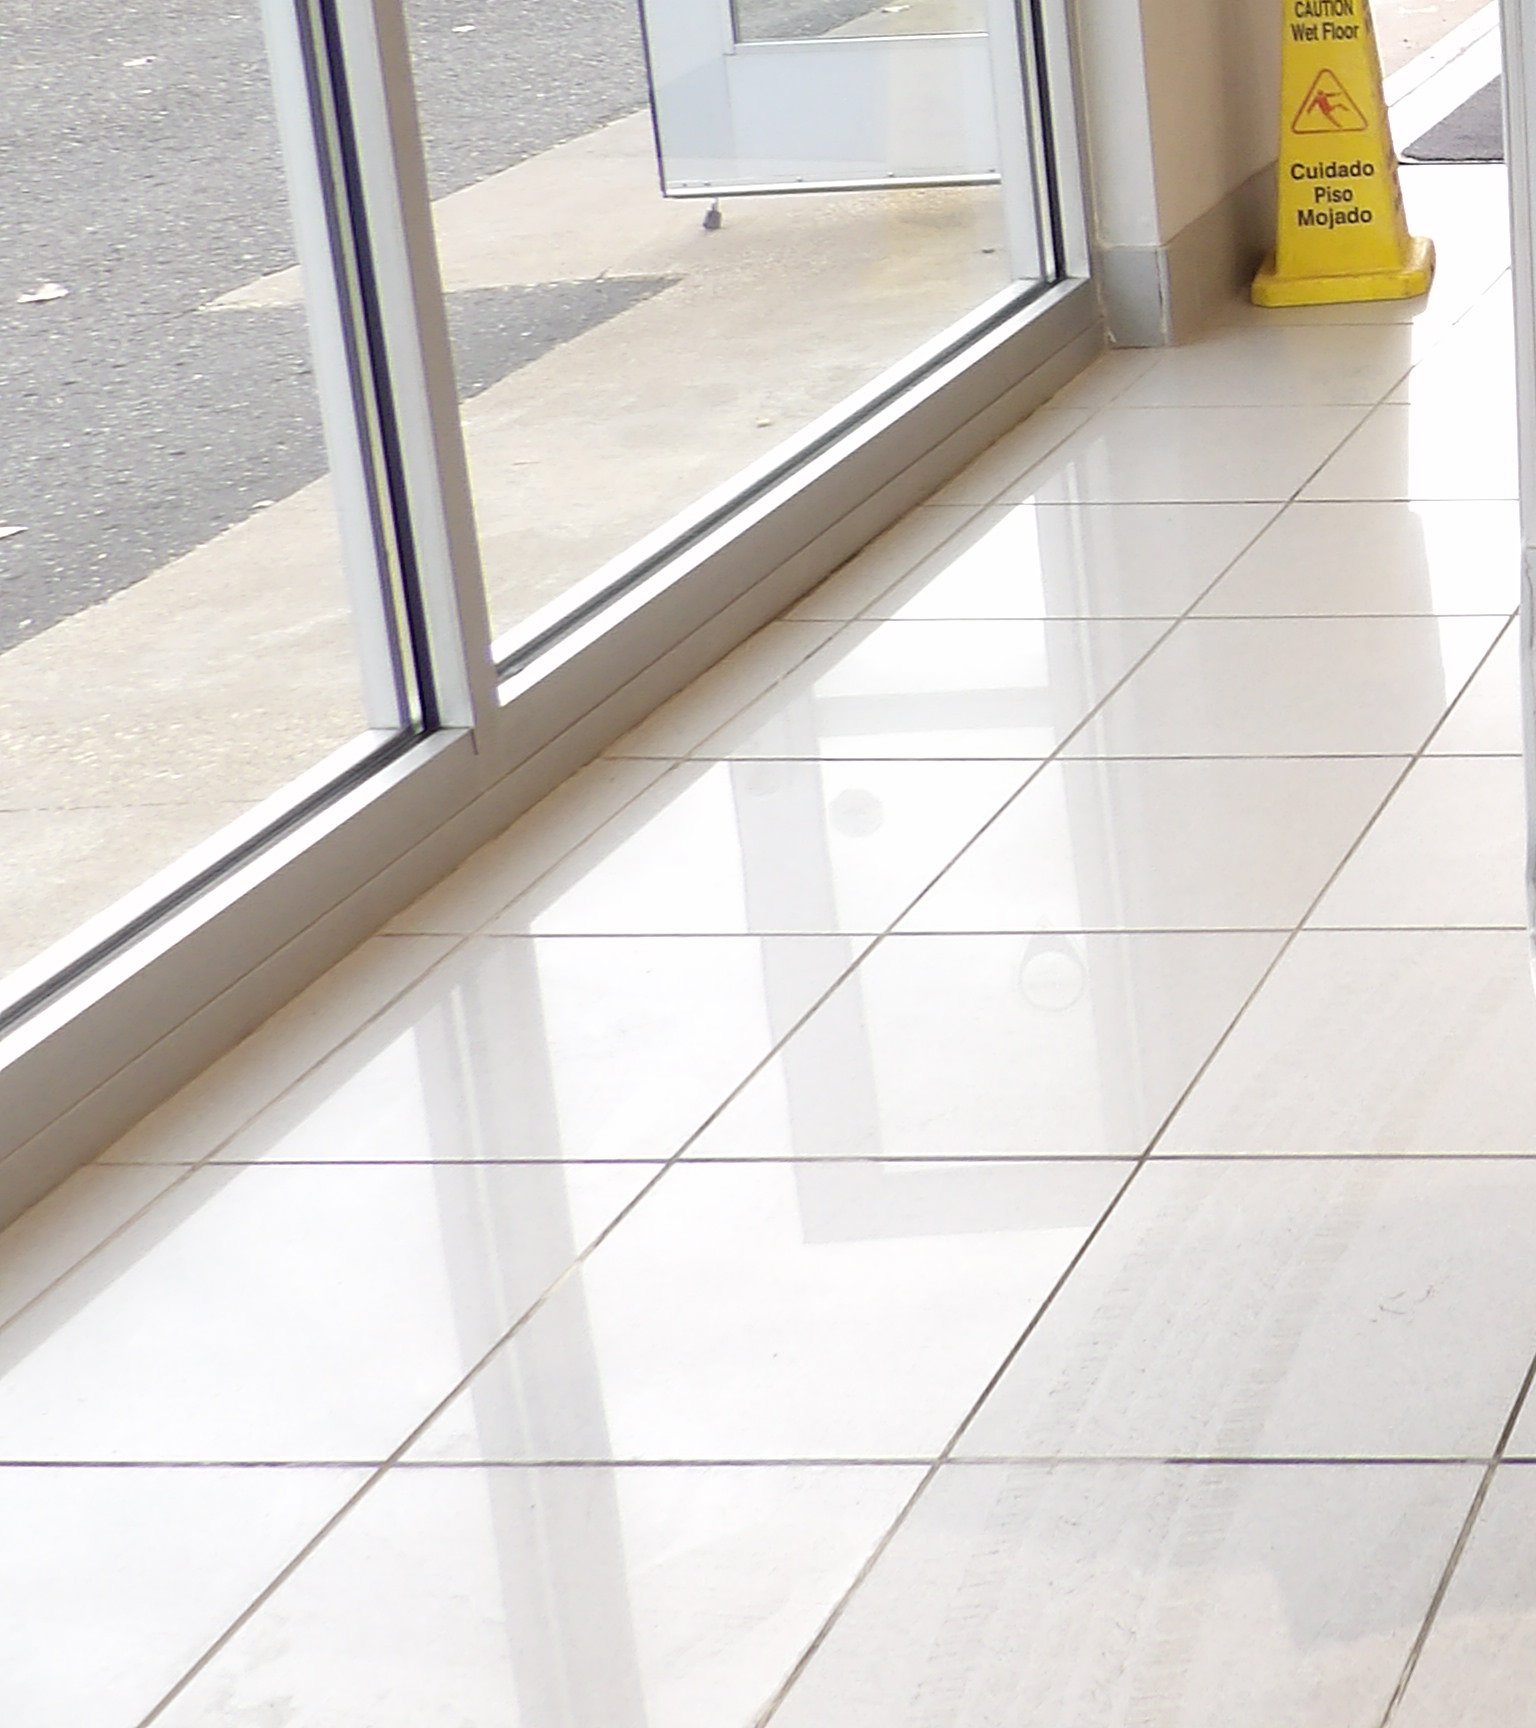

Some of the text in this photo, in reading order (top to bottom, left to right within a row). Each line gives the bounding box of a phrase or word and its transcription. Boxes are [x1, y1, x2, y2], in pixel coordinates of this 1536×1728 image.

[1295, 0, 1354, 18] CAUTION
[1291, 22, 1359, 41] Wet Floor
[1290, 160, 1374, 180] Cuidado
[1314, 186, 1353, 203] Piso
[1298, 207, 1372, 229] Mojado
